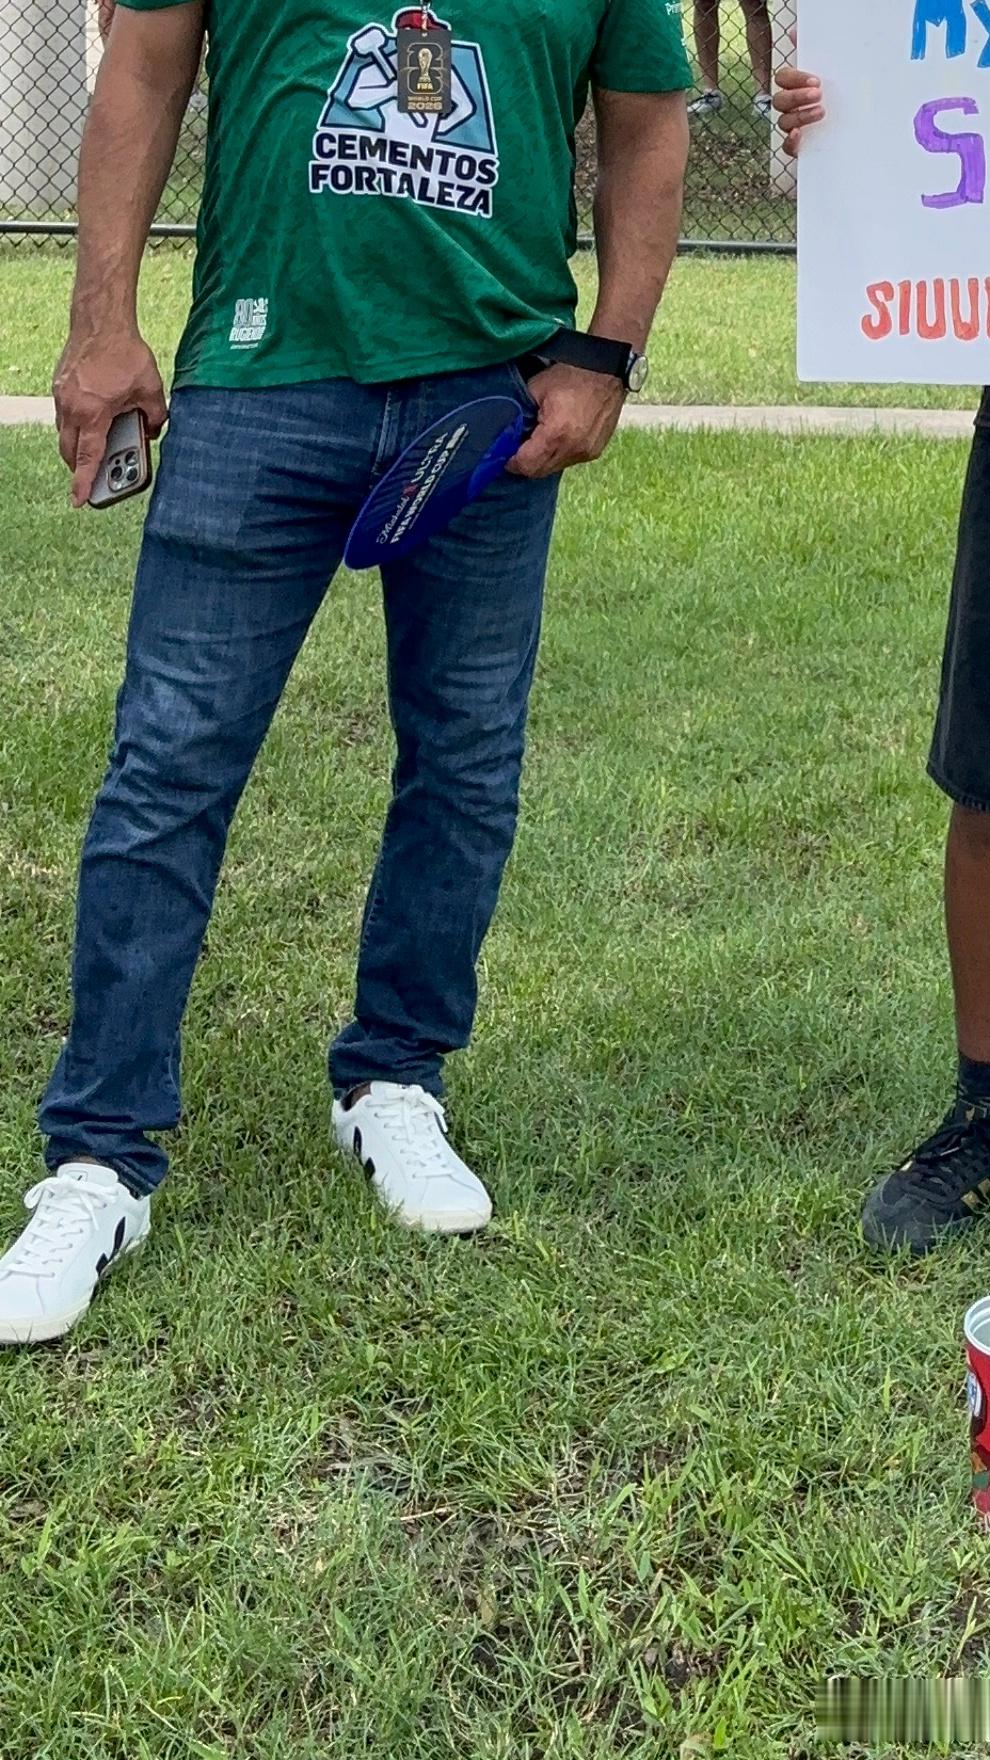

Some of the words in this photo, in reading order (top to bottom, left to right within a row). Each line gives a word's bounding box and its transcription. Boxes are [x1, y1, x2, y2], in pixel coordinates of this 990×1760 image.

[407, 102, 442, 111] 2026
[316, 133, 497, 185] CEMENTOS
[311, 163, 492, 215] FORTALEZA
[411, 432, 448, 483] ULTRA
